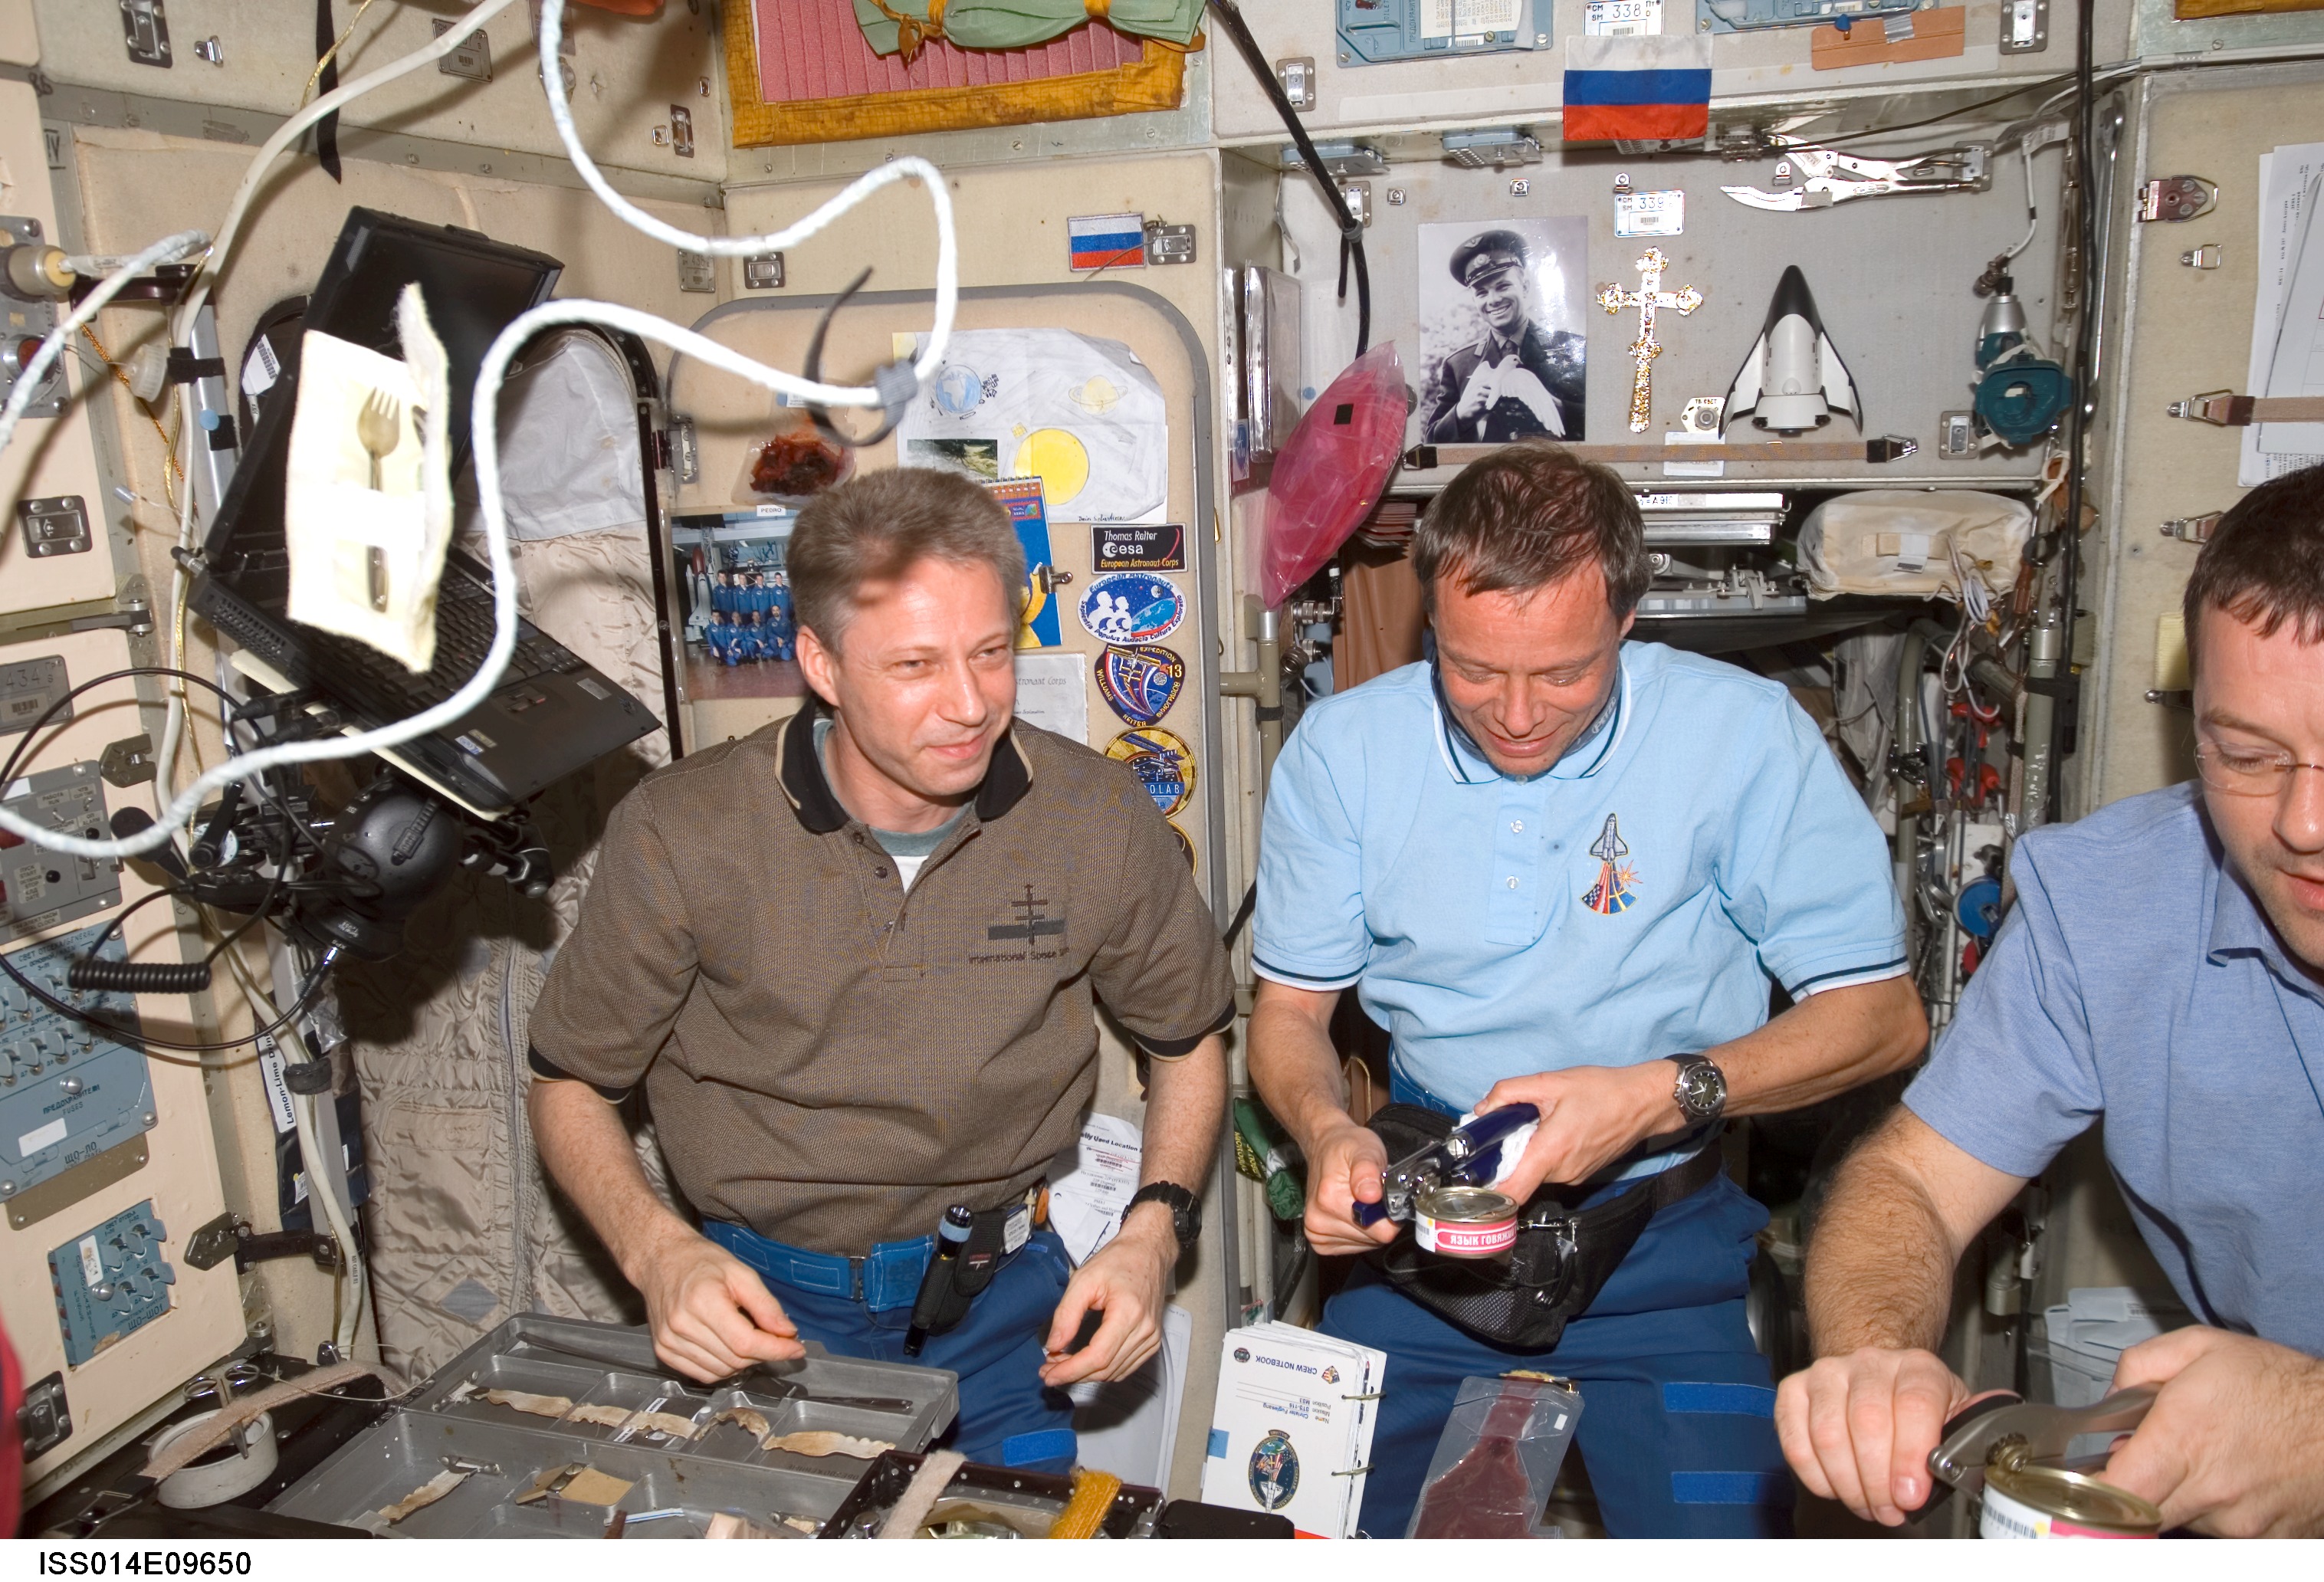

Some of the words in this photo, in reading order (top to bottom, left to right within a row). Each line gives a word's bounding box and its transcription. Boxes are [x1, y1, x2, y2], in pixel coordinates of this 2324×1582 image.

[1613, 4, 1641, 18] 338
[1640, 197, 1664, 209] 339
[1104, 530, 1132, 541] Thomas
[1134, 530, 1157, 541] Reiter
[1119, 545, 1143, 554] esa
[1101, 559, 1129, 569] European
[1131, 558, 1160, 568] Astronaut
[1161, 558, 1179, 569] Corps
[1089, 573, 1124, 592] European
[1128, 573, 1174, 591] Astronauts
[1140, 646, 1177, 662] EXPEDITION
[6, 668, 40, 688] 434
[1167, 665, 1183, 678] 13
[1096, 668, 1114, 701] WILLIAMS
[1122, 714, 1147, 727] REITER
[267, 1034, 276, 1058] Drin
[271, 1062, 294, 1124] Lemon-Lime
[62, 1101, 84, 1116] FUSES
[1094, 1135, 1110, 1145] Used
[1111, 1140, 1138, 1152] Location
[1450, 1235, 1479, 1246] ЯЗЫК
[1256, 1355, 1295, 1370] NOTEBOOK
[1295, 1364, 1318, 1375] CREW
[1312, 1407, 1331, 1417] Mission
